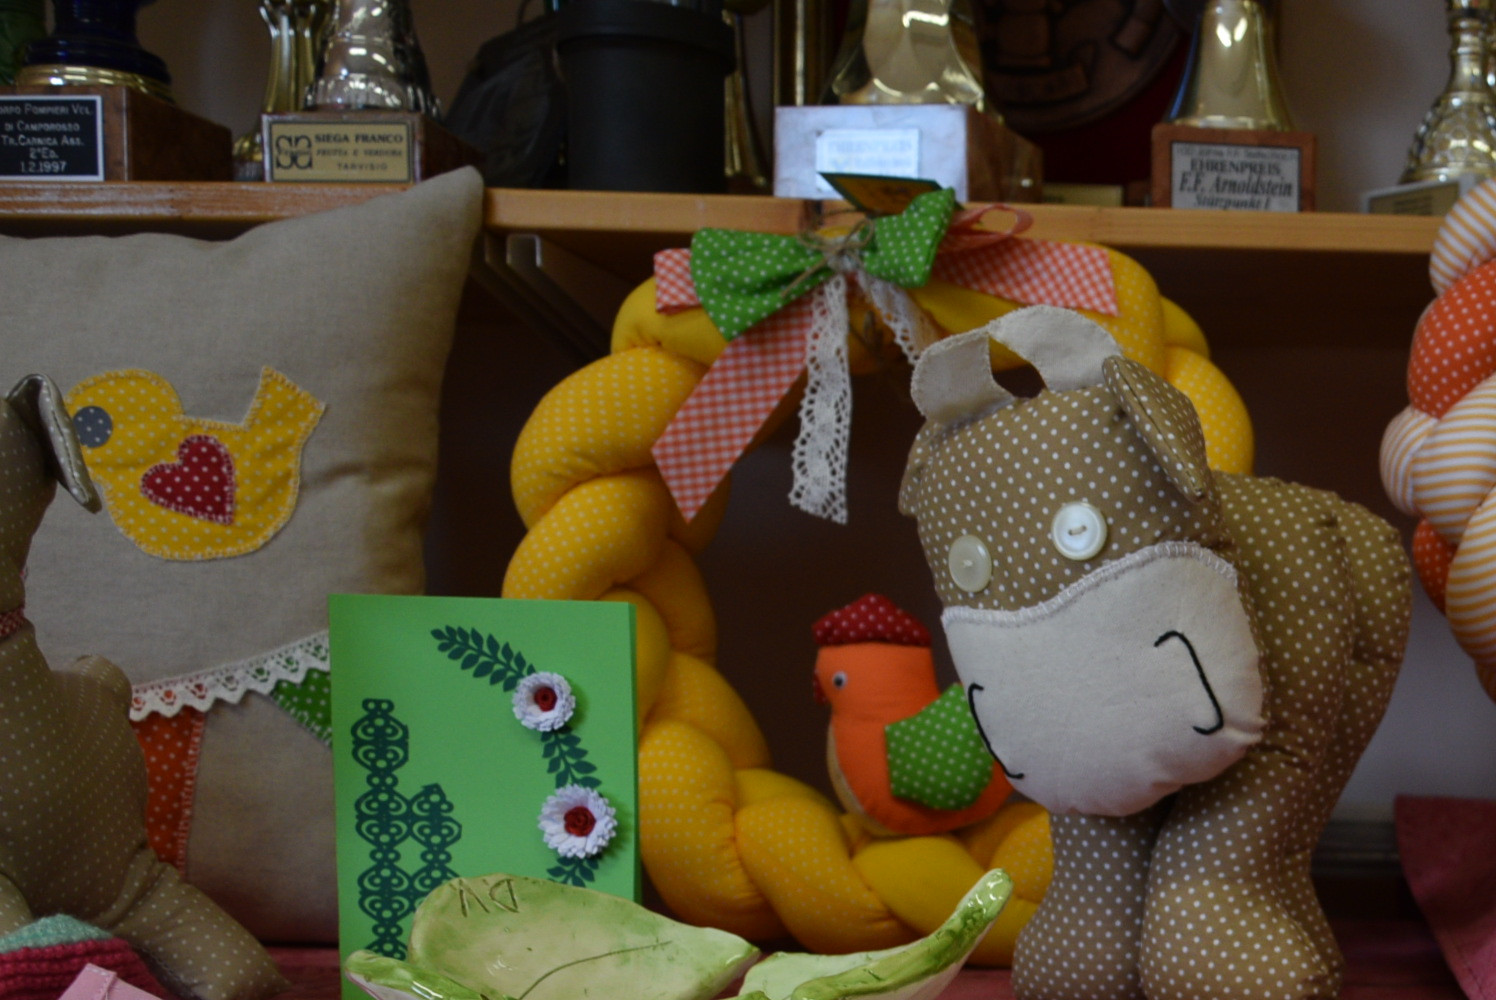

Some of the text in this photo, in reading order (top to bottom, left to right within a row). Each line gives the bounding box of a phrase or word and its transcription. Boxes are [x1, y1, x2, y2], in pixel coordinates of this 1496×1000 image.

[314, 133, 404, 144] SIEGA FRANCO
[337, 162, 388, 171] TARVISIO
[1190, 158, 1282, 176] EHRENPREIS
[1179, 171, 1293, 197] F.F. Arnoldstein
